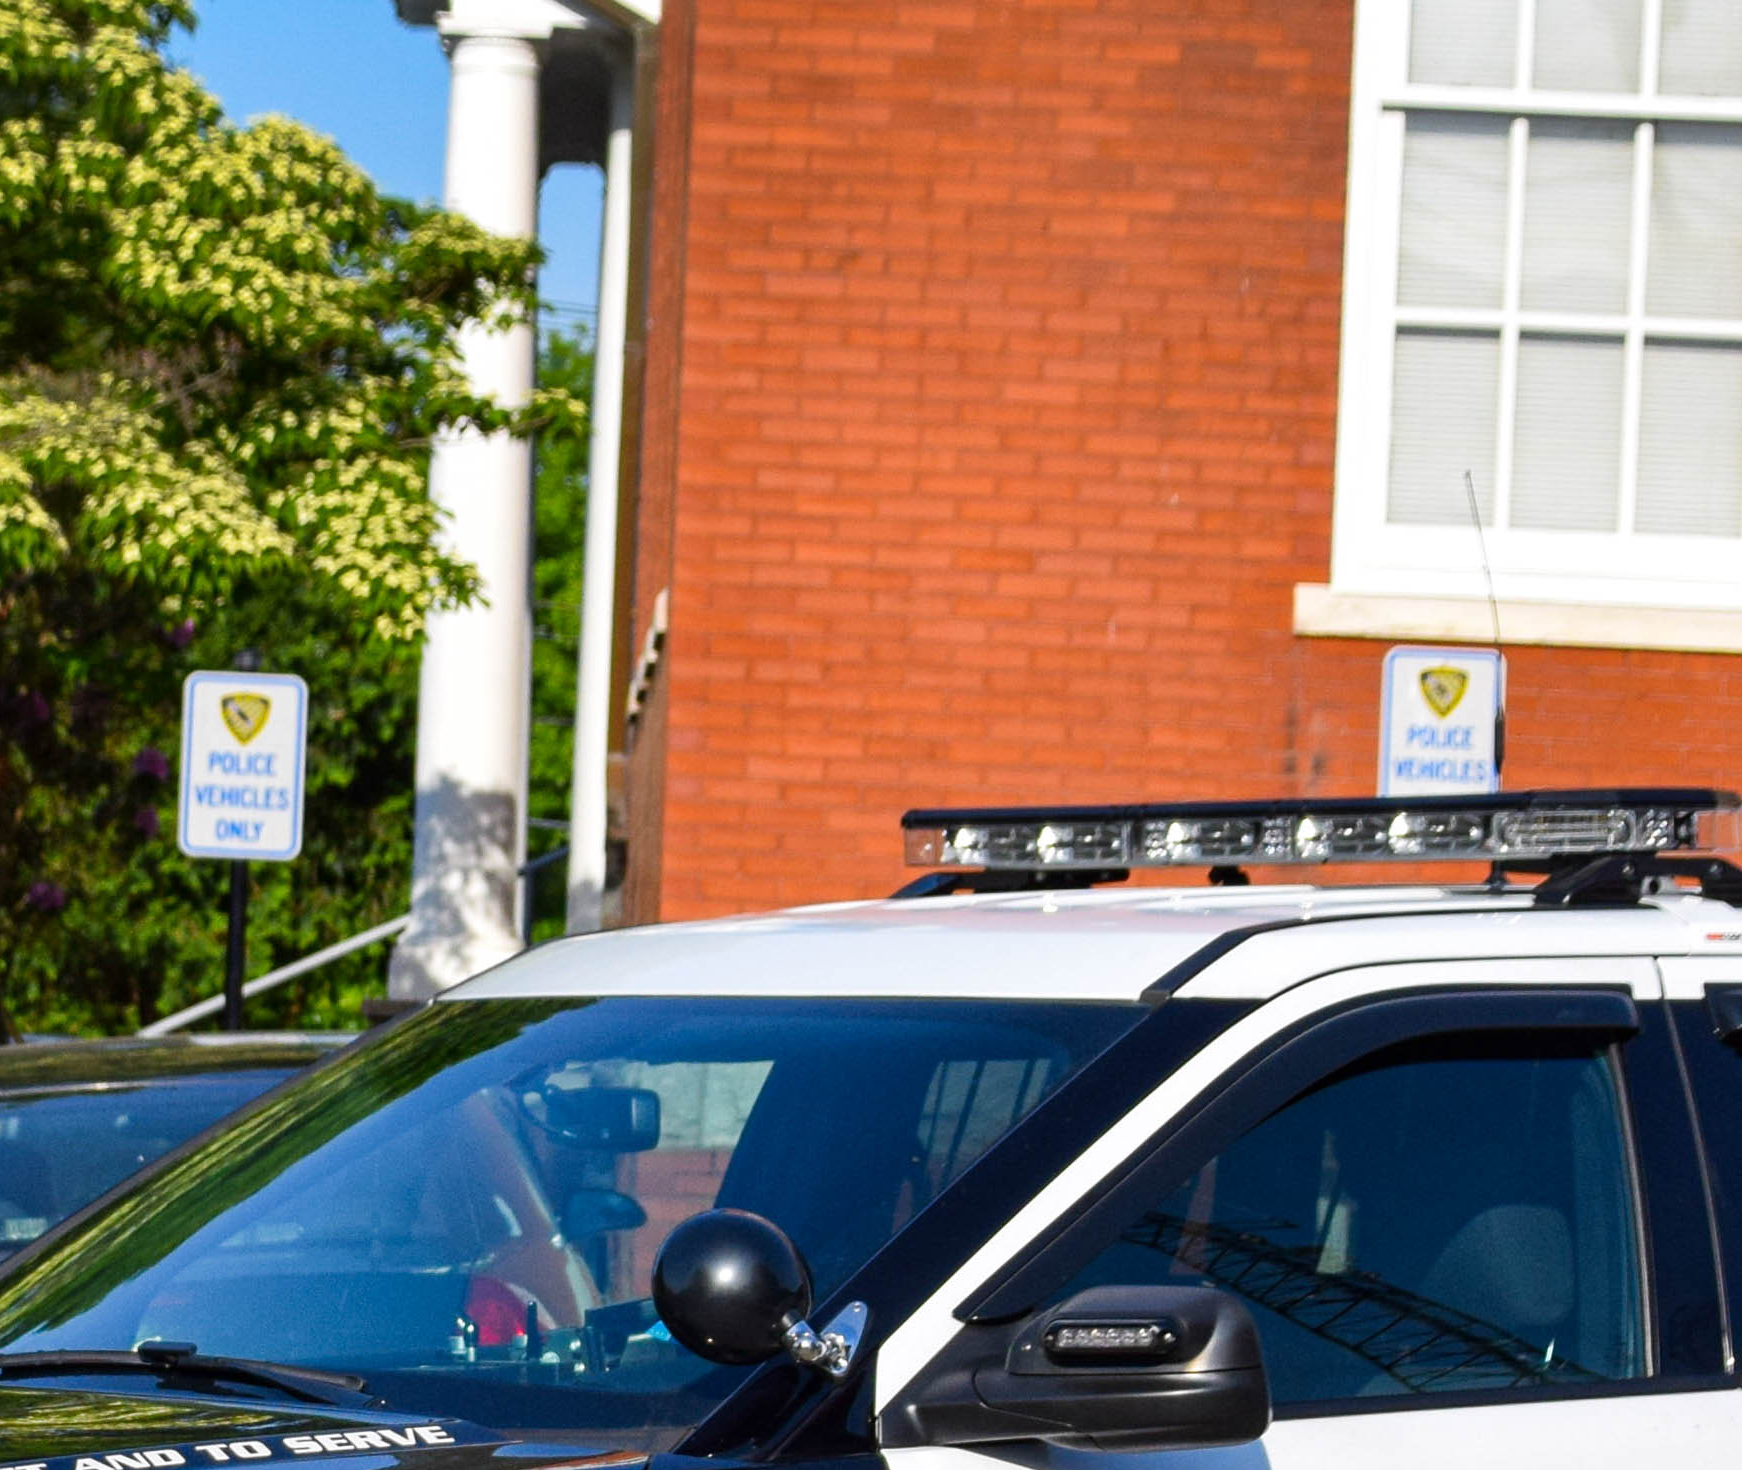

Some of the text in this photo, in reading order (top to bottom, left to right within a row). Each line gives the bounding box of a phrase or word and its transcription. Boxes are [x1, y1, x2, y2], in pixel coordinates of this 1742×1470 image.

[1406, 723, 1475, 749] POLICE
[208, 751, 276, 777] POLICE
[1395, 758, 1488, 783] VEHICLES
[195, 785, 290, 811] VEHICLES
[215, 819, 265, 843] ONLY
[194, 1440, 273, 1463] TO
[281, 1425, 456, 1455] SERVE
